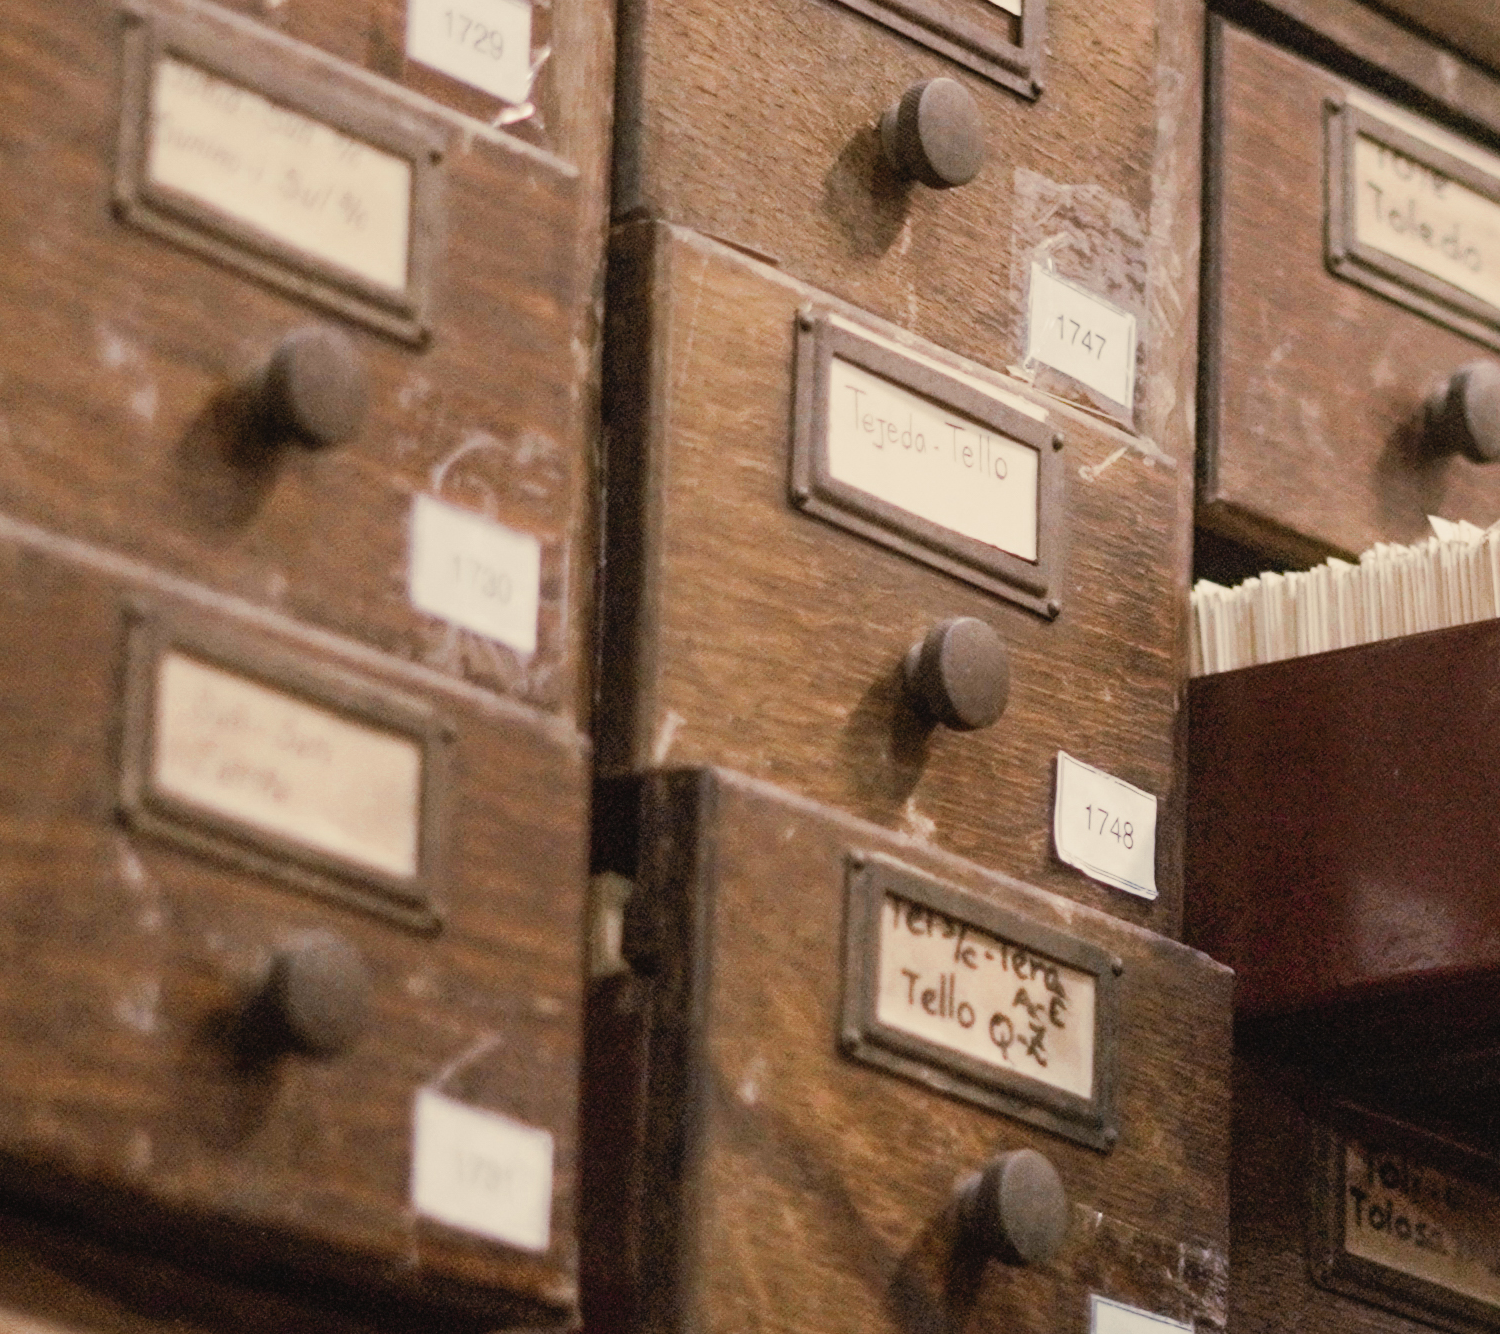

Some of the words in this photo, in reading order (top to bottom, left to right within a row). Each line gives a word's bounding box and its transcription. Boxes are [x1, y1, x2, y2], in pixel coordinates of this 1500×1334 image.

[443, 8, 505, 60] 1729
[1056, 312, 1108, 362] 1747
[1084, 802, 1136, 851] 1748
[899, 967, 978, 1030] Tello
